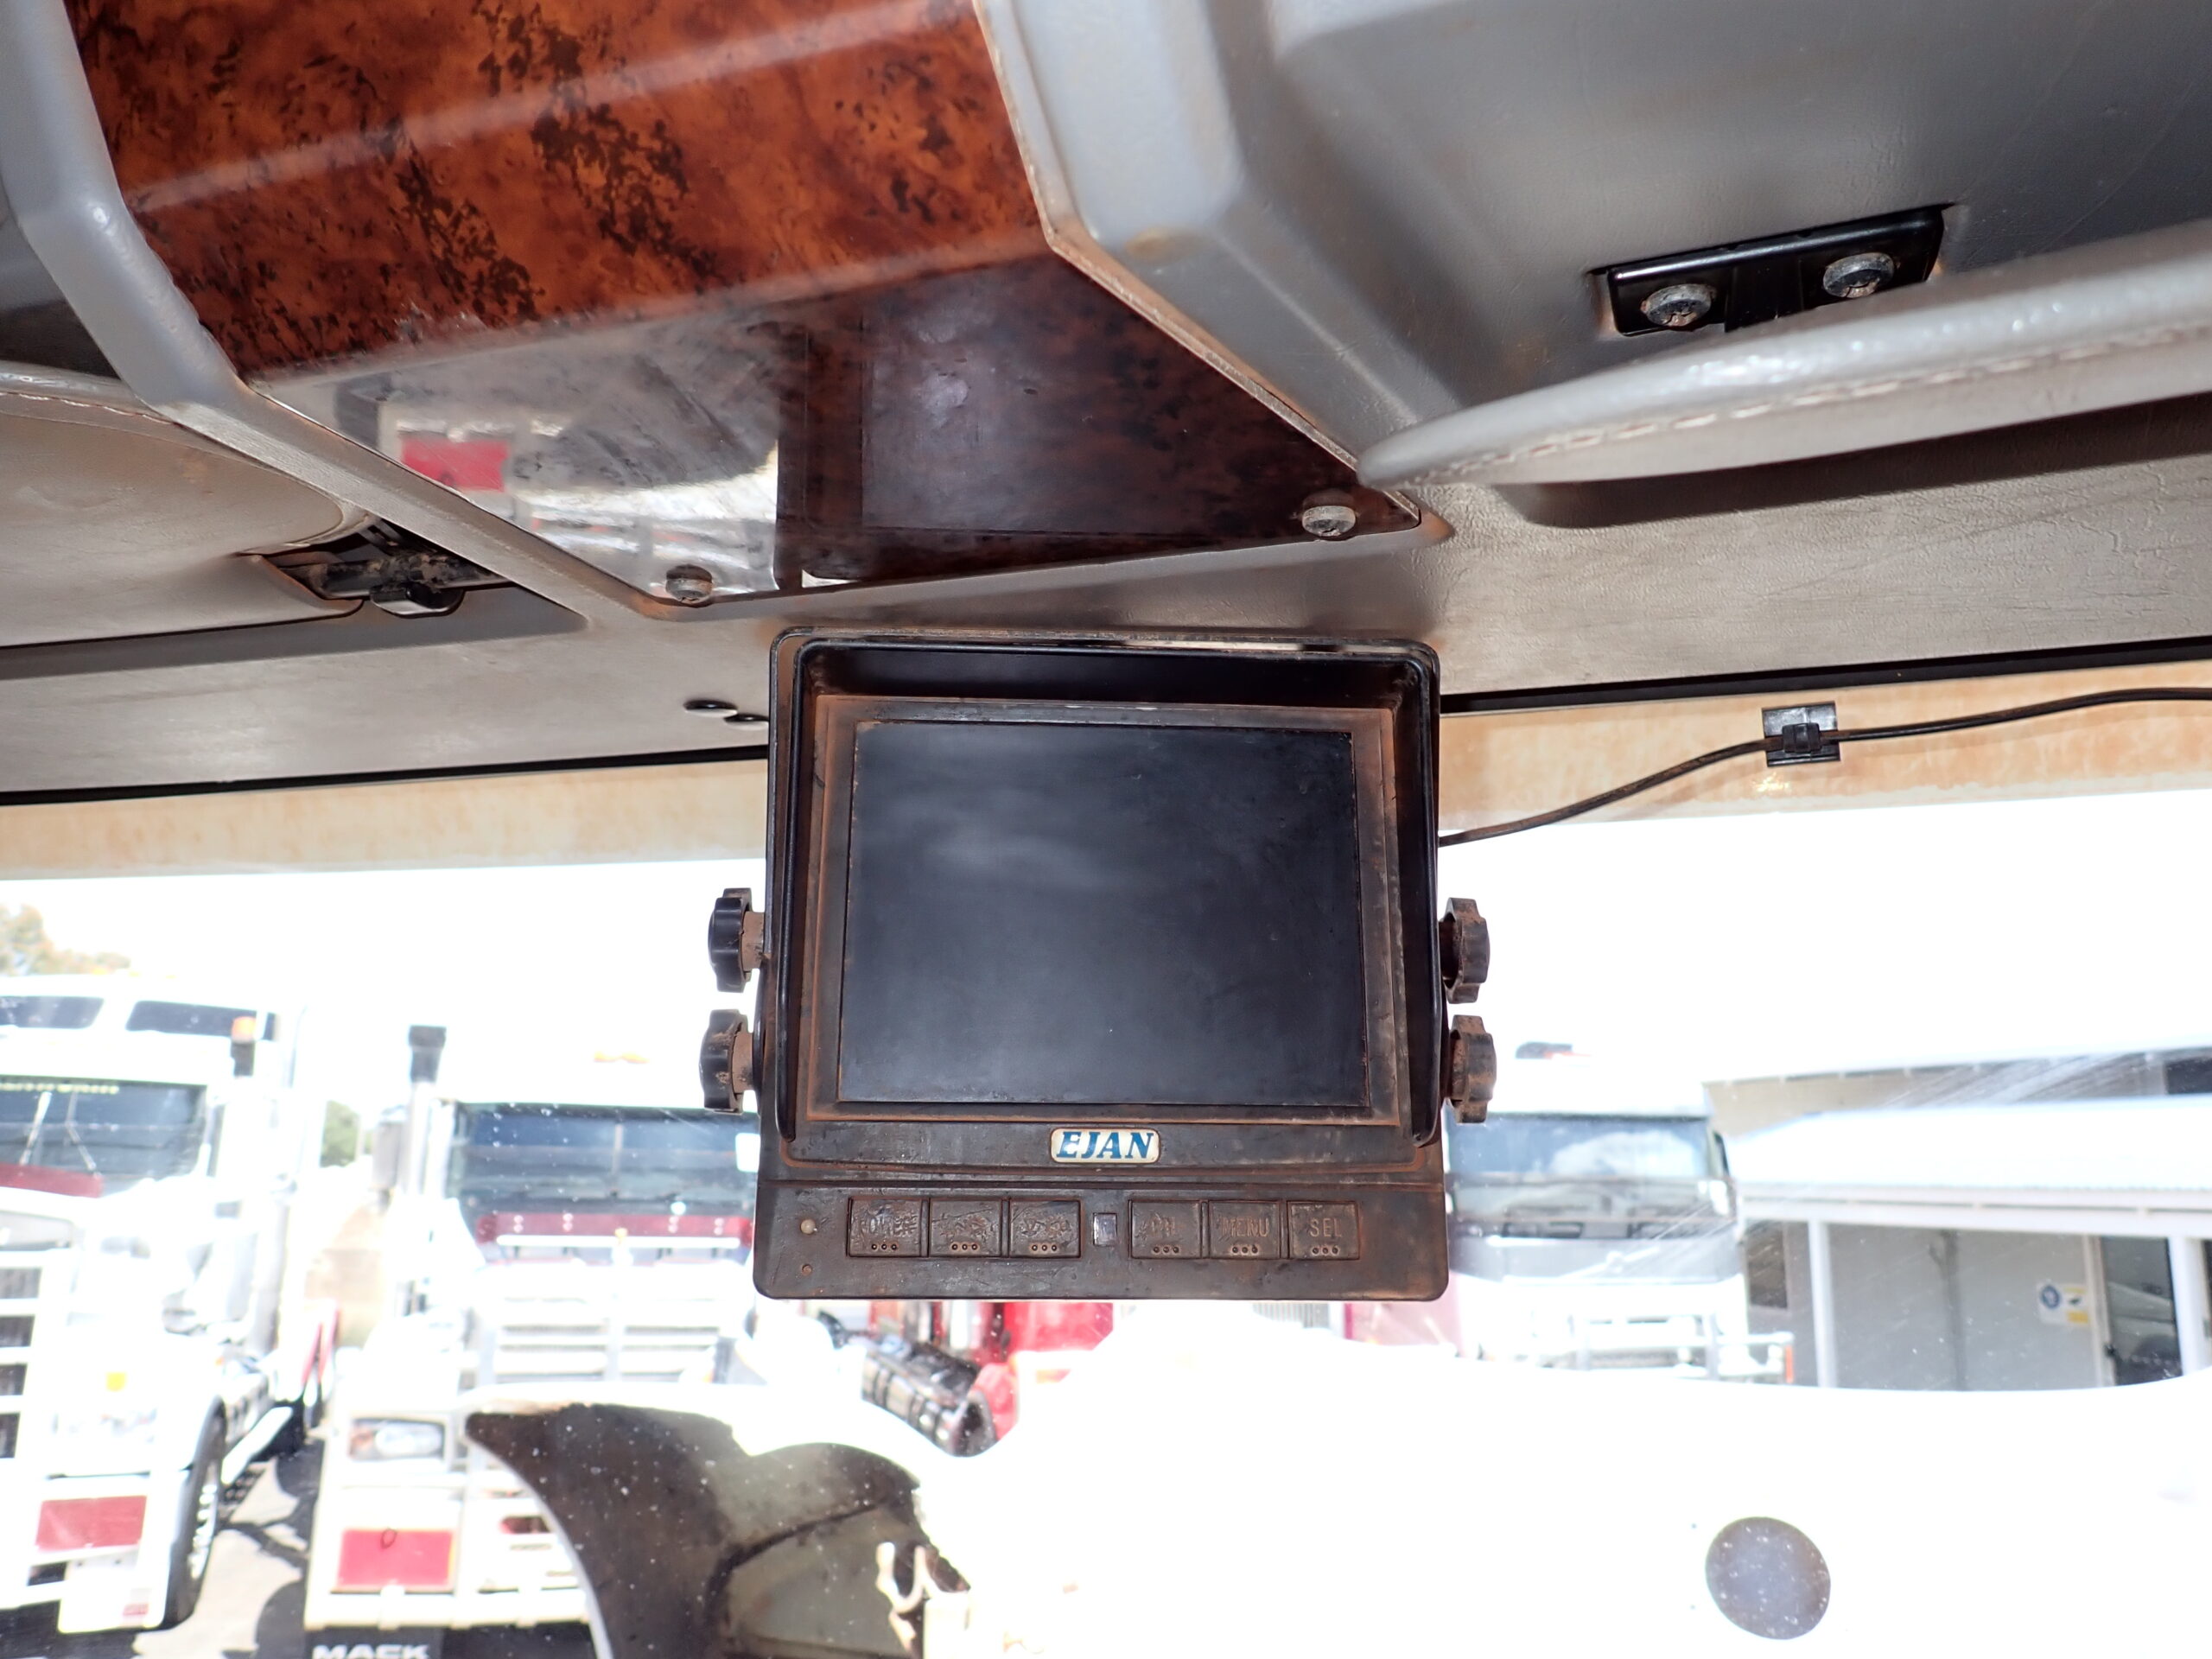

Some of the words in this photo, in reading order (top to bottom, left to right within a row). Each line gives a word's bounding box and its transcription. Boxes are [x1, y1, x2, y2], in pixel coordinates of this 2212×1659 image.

[1056, 1131, 1154, 1159] EJAN
[1221, 1217, 1270, 1238] MENU
[1309, 1217, 1343, 1238] SEL
